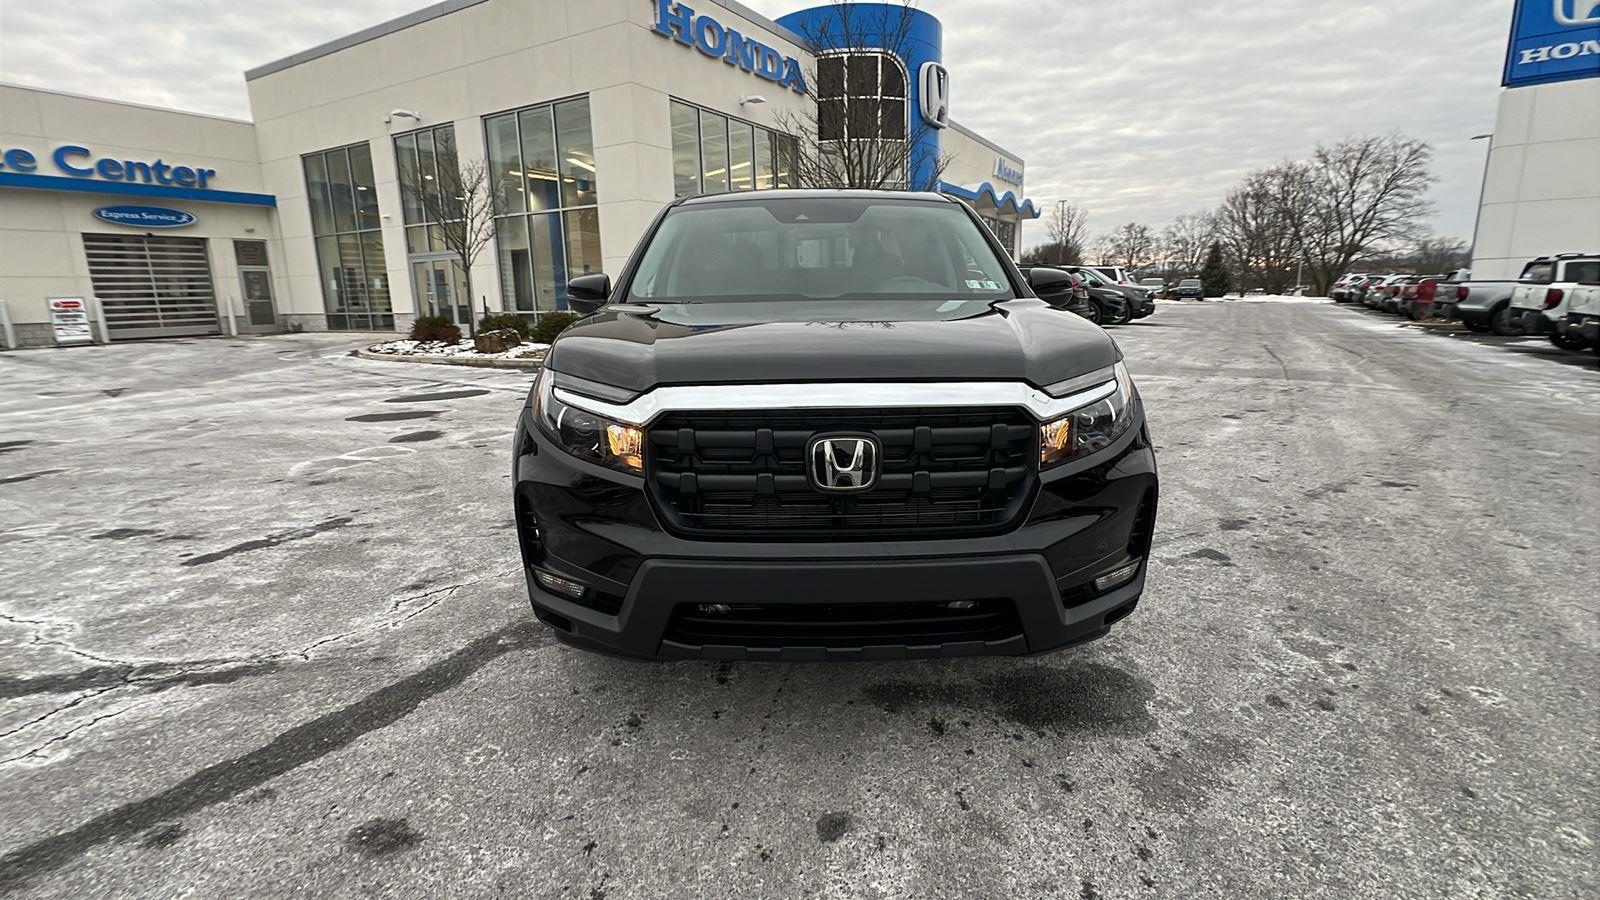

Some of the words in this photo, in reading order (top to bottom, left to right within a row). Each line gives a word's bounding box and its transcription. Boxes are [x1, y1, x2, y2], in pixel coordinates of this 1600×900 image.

[650, 0, 808, 95] HONDA
[0, 148, 38, 173] e
[53, 145, 216, 188] Center
[100, 209, 140, 219] Express
[141, 212, 177, 222] Service
